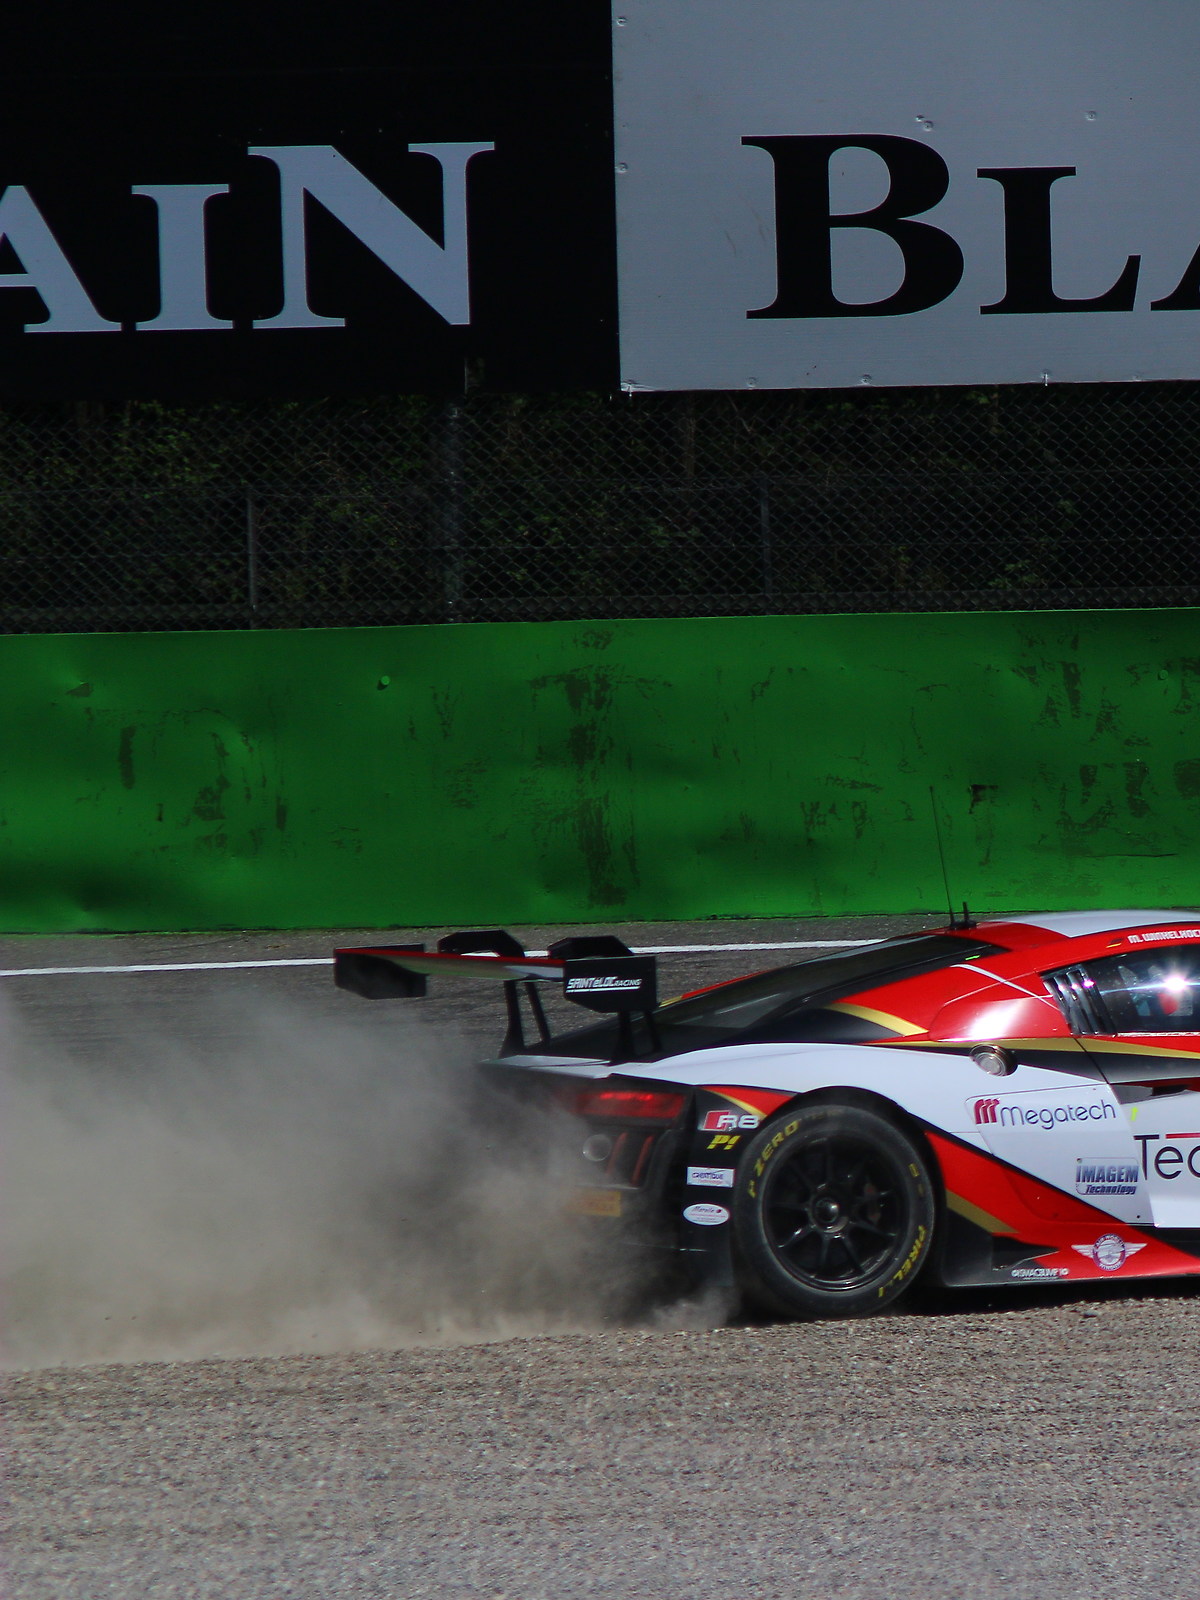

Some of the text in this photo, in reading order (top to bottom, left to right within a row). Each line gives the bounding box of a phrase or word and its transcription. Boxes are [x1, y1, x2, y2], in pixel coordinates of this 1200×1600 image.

[717, 1114, 760, 1130] R8
[1000, 1100, 1116, 1130] Megatech
[754, 1119, 801, 1178] ZERO
[1075, 1165, 1139, 1183] IMAGEM
[1085, 1184, 1137, 1195] Technology
